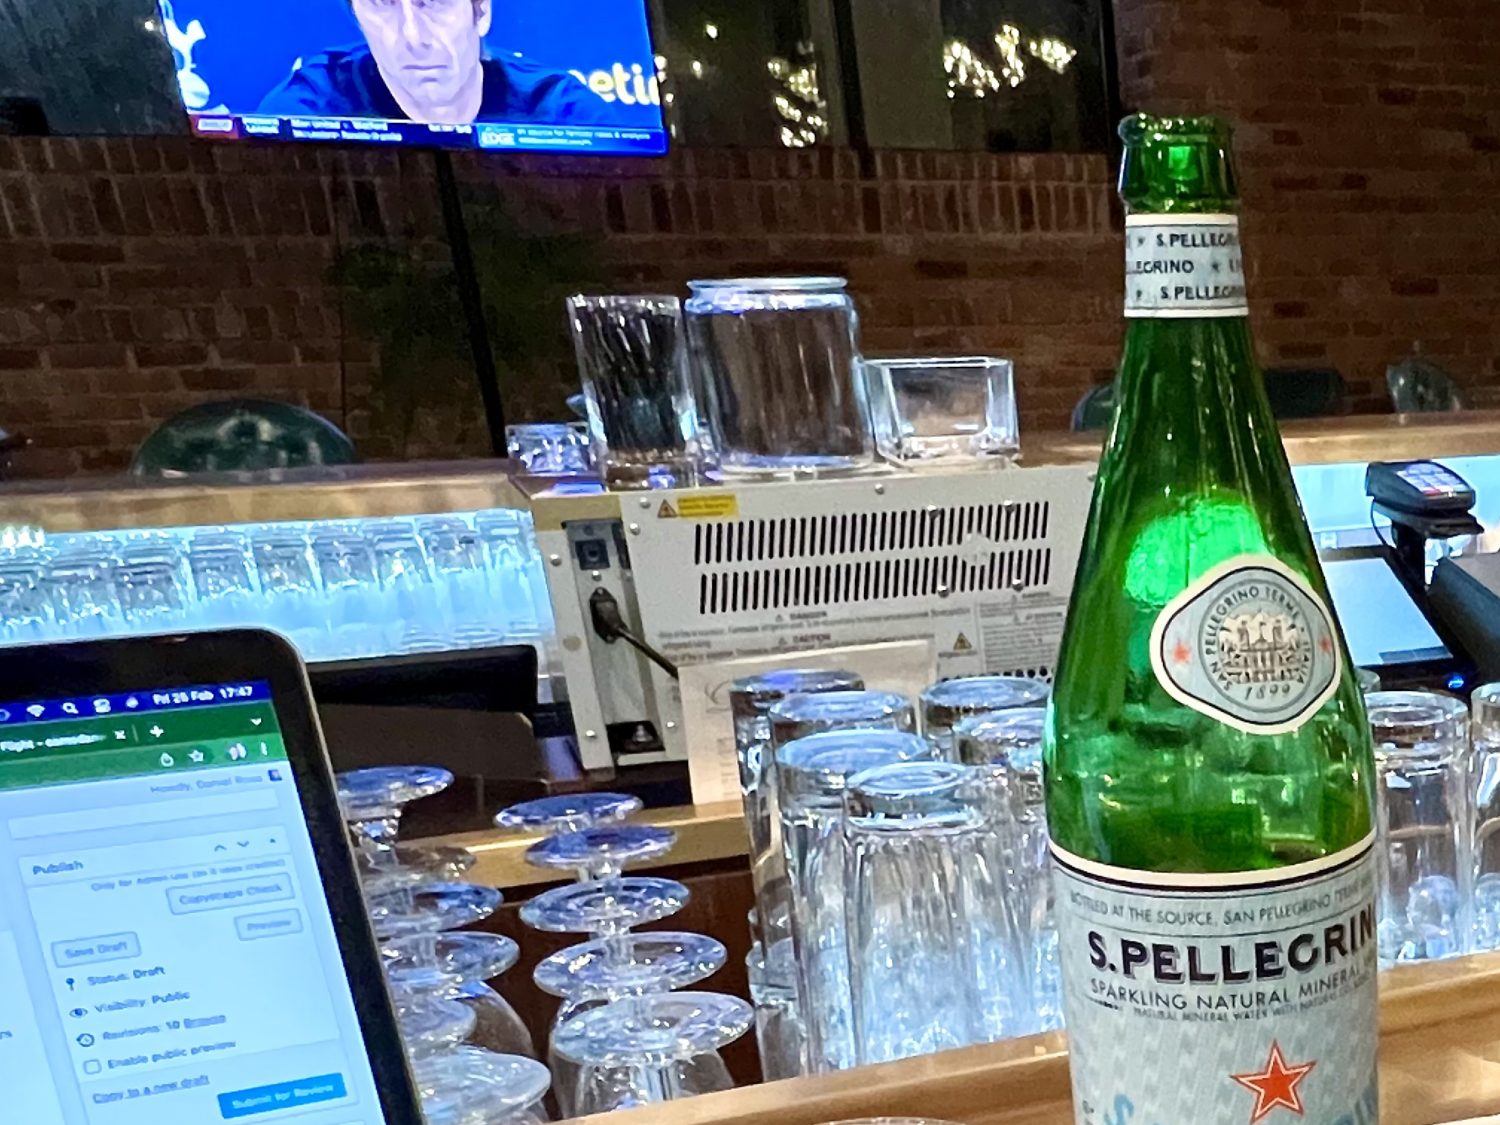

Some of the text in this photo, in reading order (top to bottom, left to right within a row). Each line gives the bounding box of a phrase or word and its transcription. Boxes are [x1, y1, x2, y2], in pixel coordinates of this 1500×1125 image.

[1112, 905, 1124, 917] AT
[1128, 906, 1152, 923] THE
[1223, 909, 1255, 926] SAN
[1259, 894, 1331, 921] PELLEGRINO
[1087, 903, 1376, 986] S.PELLEGRIN
[1090, 977, 1188, 1011] SPARKLING
[1196, 987, 1291, 1012] NATURAL
[1298, 966, 1361, 998] MINERAL
